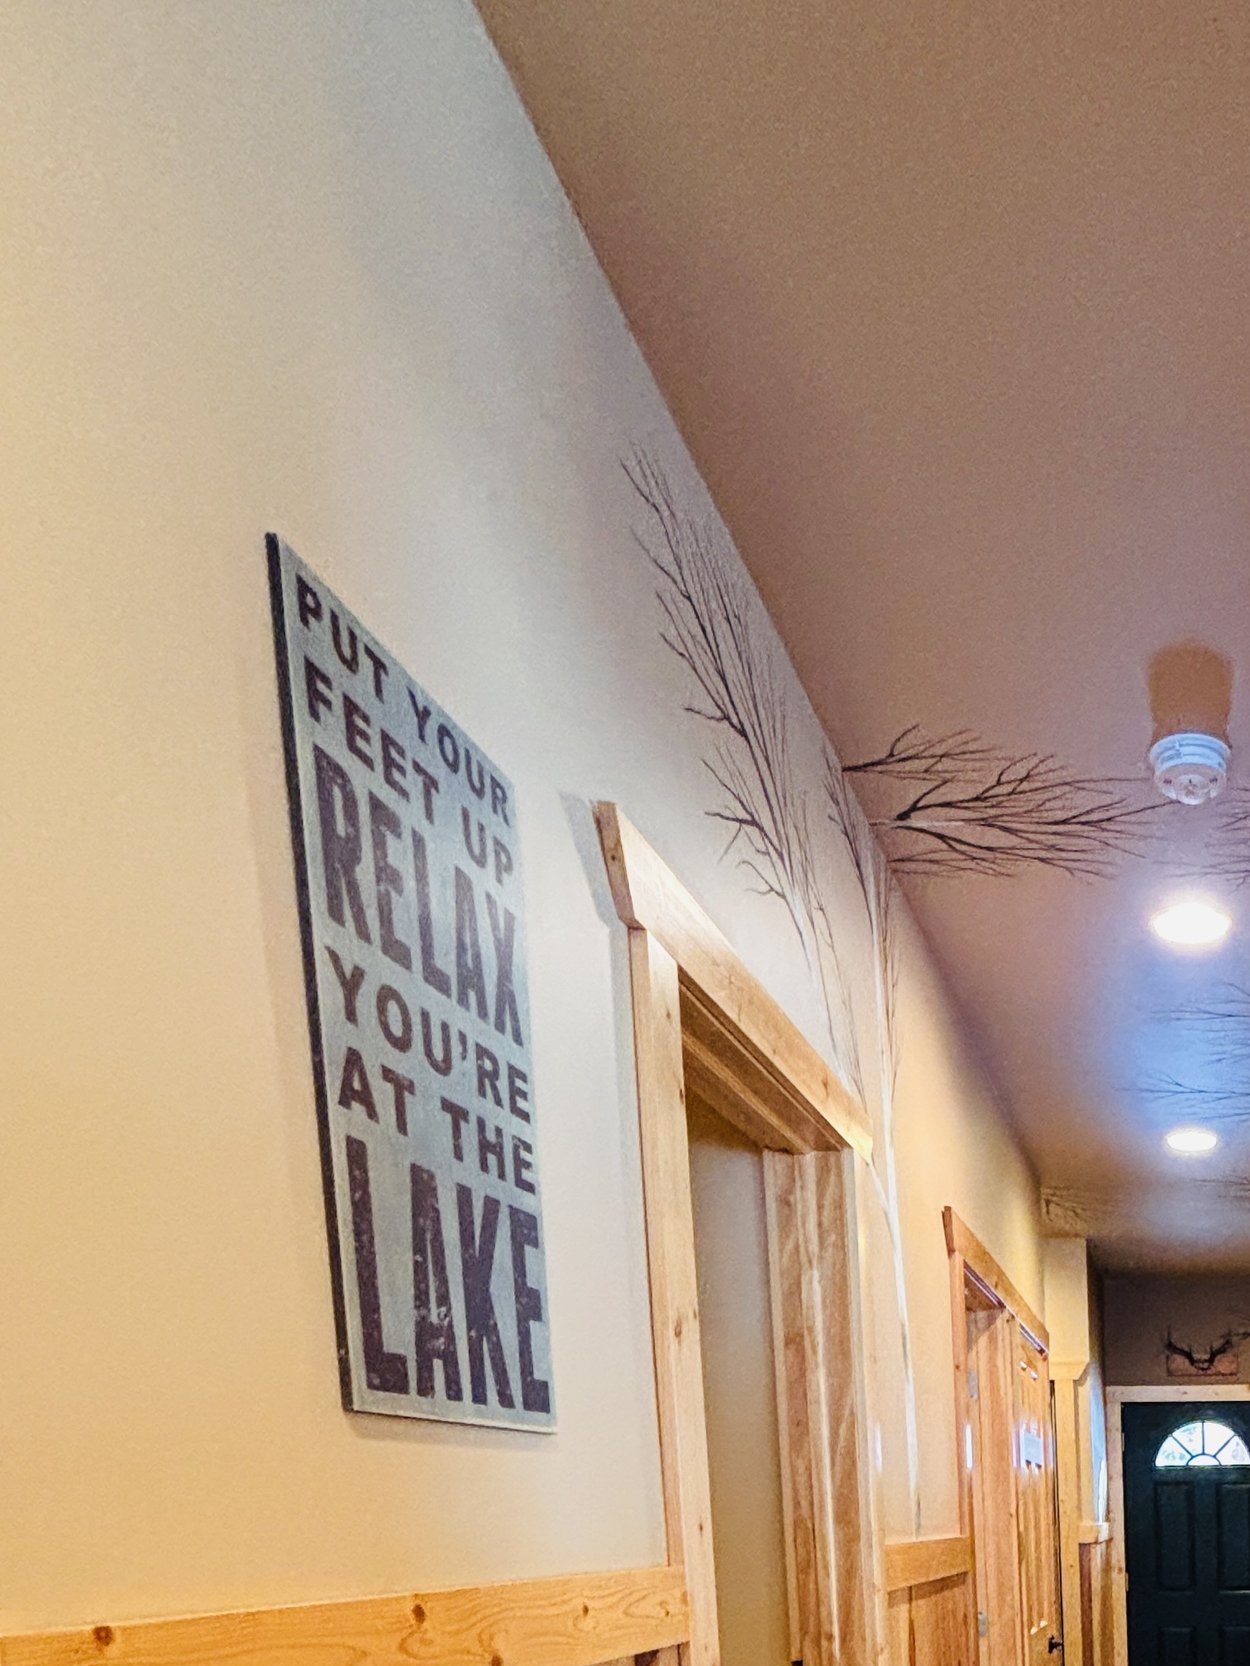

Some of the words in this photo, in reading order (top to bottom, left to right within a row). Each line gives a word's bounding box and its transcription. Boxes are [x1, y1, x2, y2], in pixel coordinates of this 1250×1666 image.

[296, 573, 389, 703] PUT
[407, 687, 511, 827] YOUR
[304, 655, 440, 825] FEET
[461, 807, 514, 885] UP
[312, 744, 523, 1046] RELAX
[325, 948, 531, 1124] YOU'RE
[337, 1046, 415, 1136] AT
[440, 1097, 535, 1195] THE
[346, 1136, 551, 1413] LAKE
